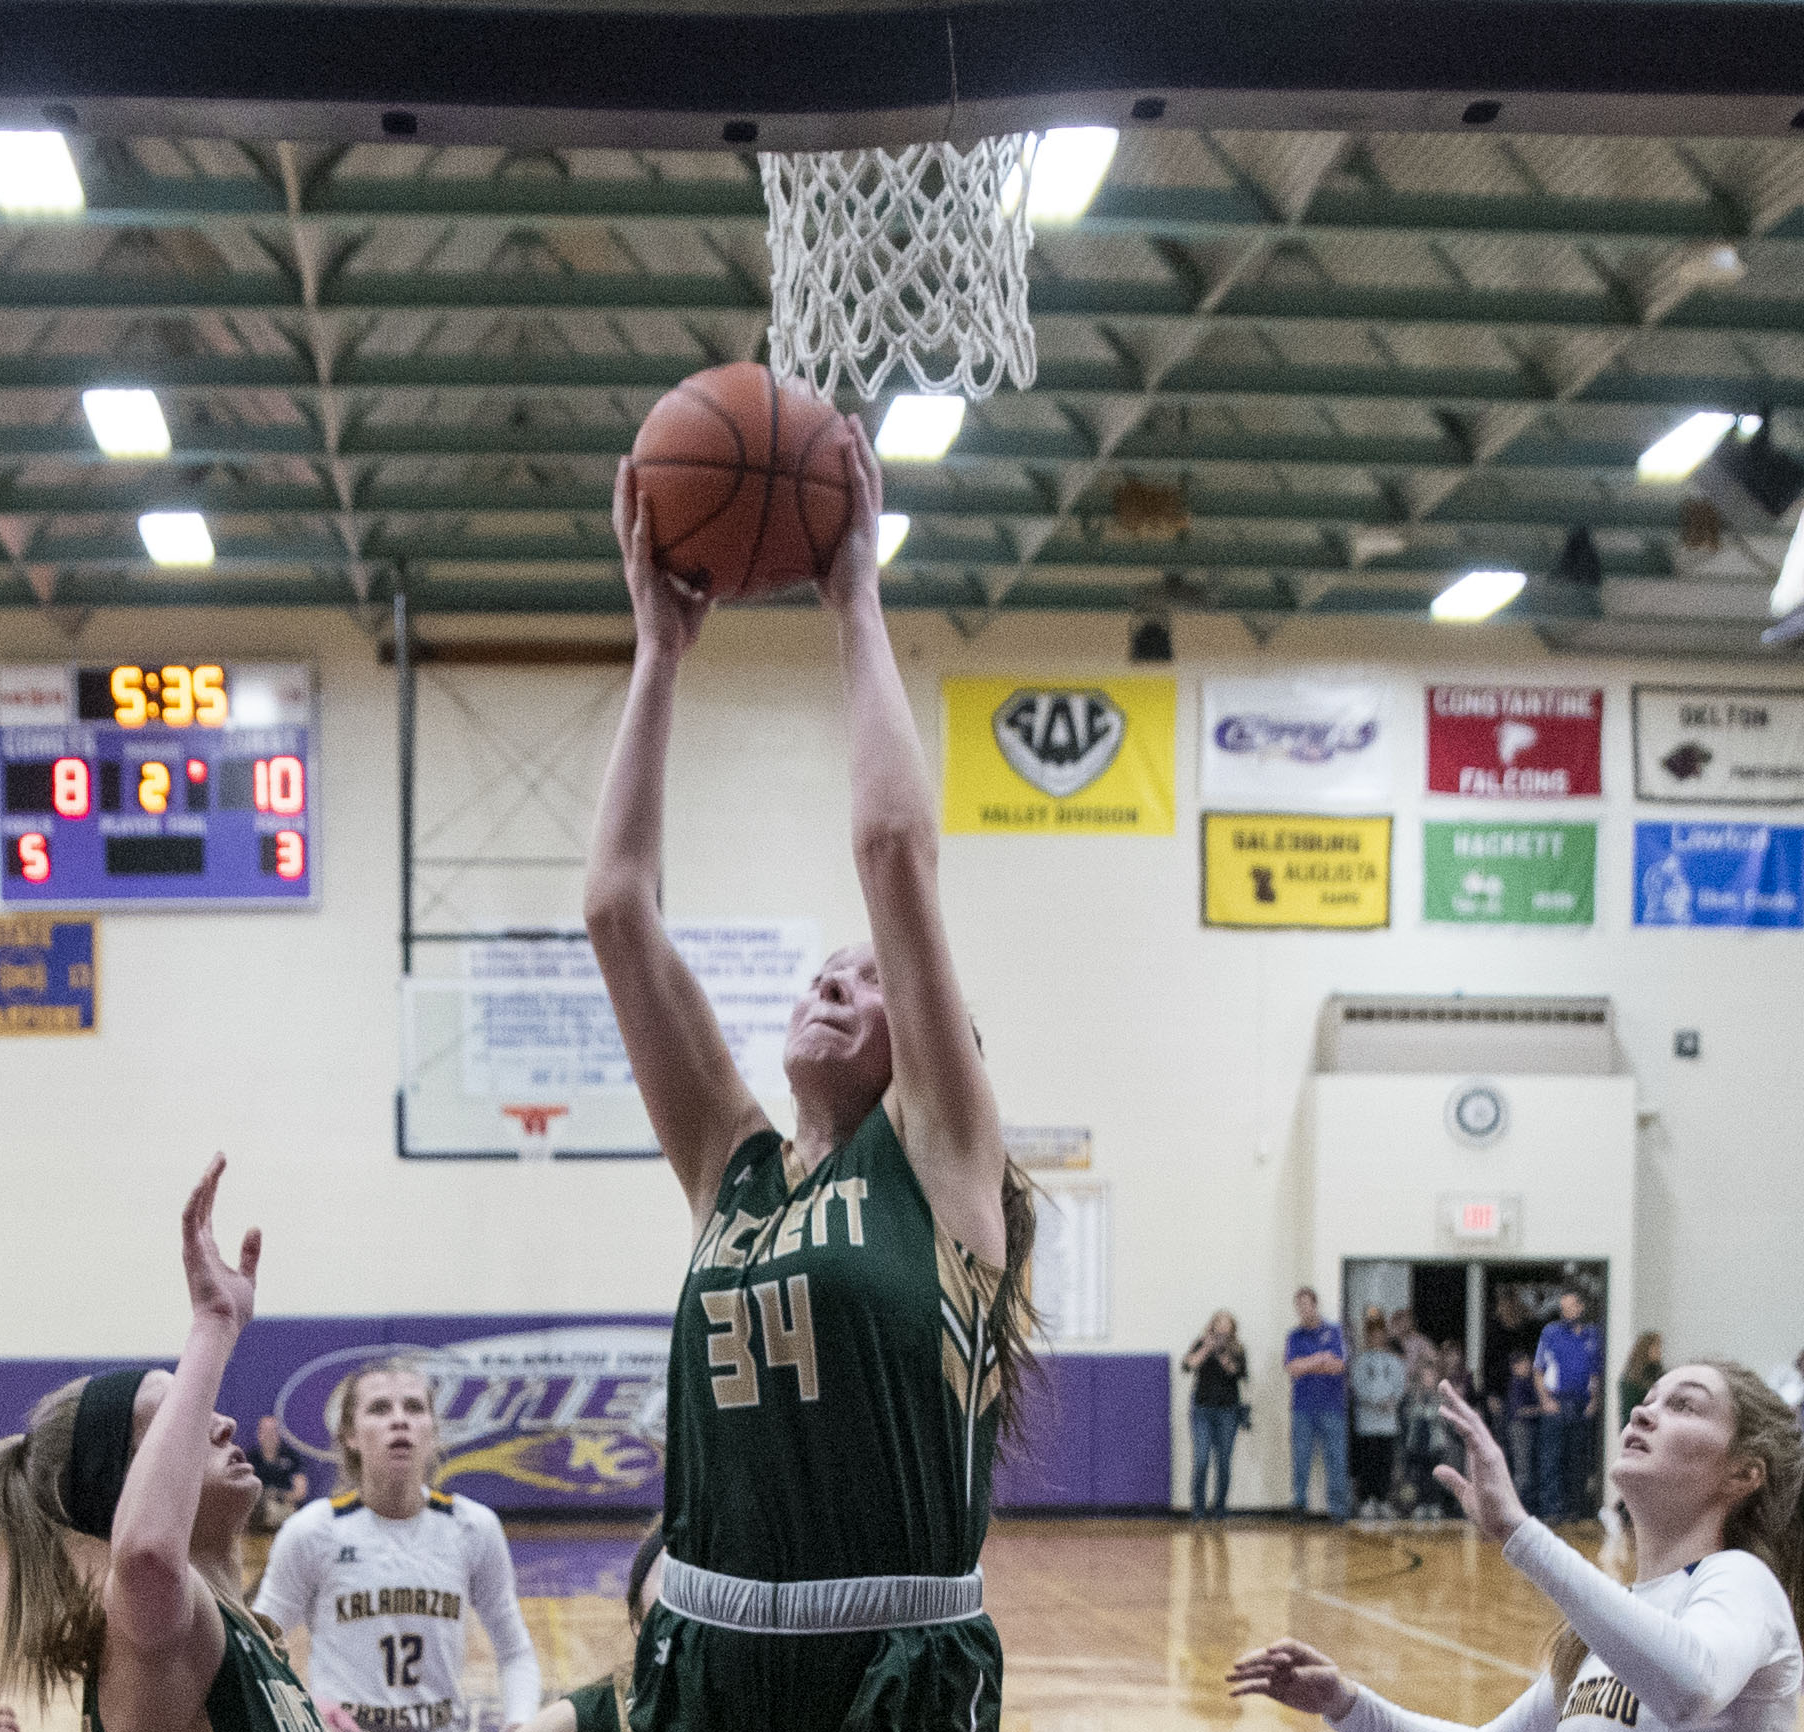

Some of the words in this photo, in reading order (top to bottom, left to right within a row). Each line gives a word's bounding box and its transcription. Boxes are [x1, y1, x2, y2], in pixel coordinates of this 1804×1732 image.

[110, 664, 228, 729] 5:35
[51, 756, 91, 820] 8
[138, 761, 171, 814] 2
[253, 755, 305, 817] 10
[1457, 766, 1569, 796] FALCONS
[18, 832, 51, 884] 5
[275, 829, 305, 881] 3
[700, 1273, 820, 1410] 34
[335, 1586, 462, 1624] KALAMAZOO
[379, 1633, 424, 1688] 12
